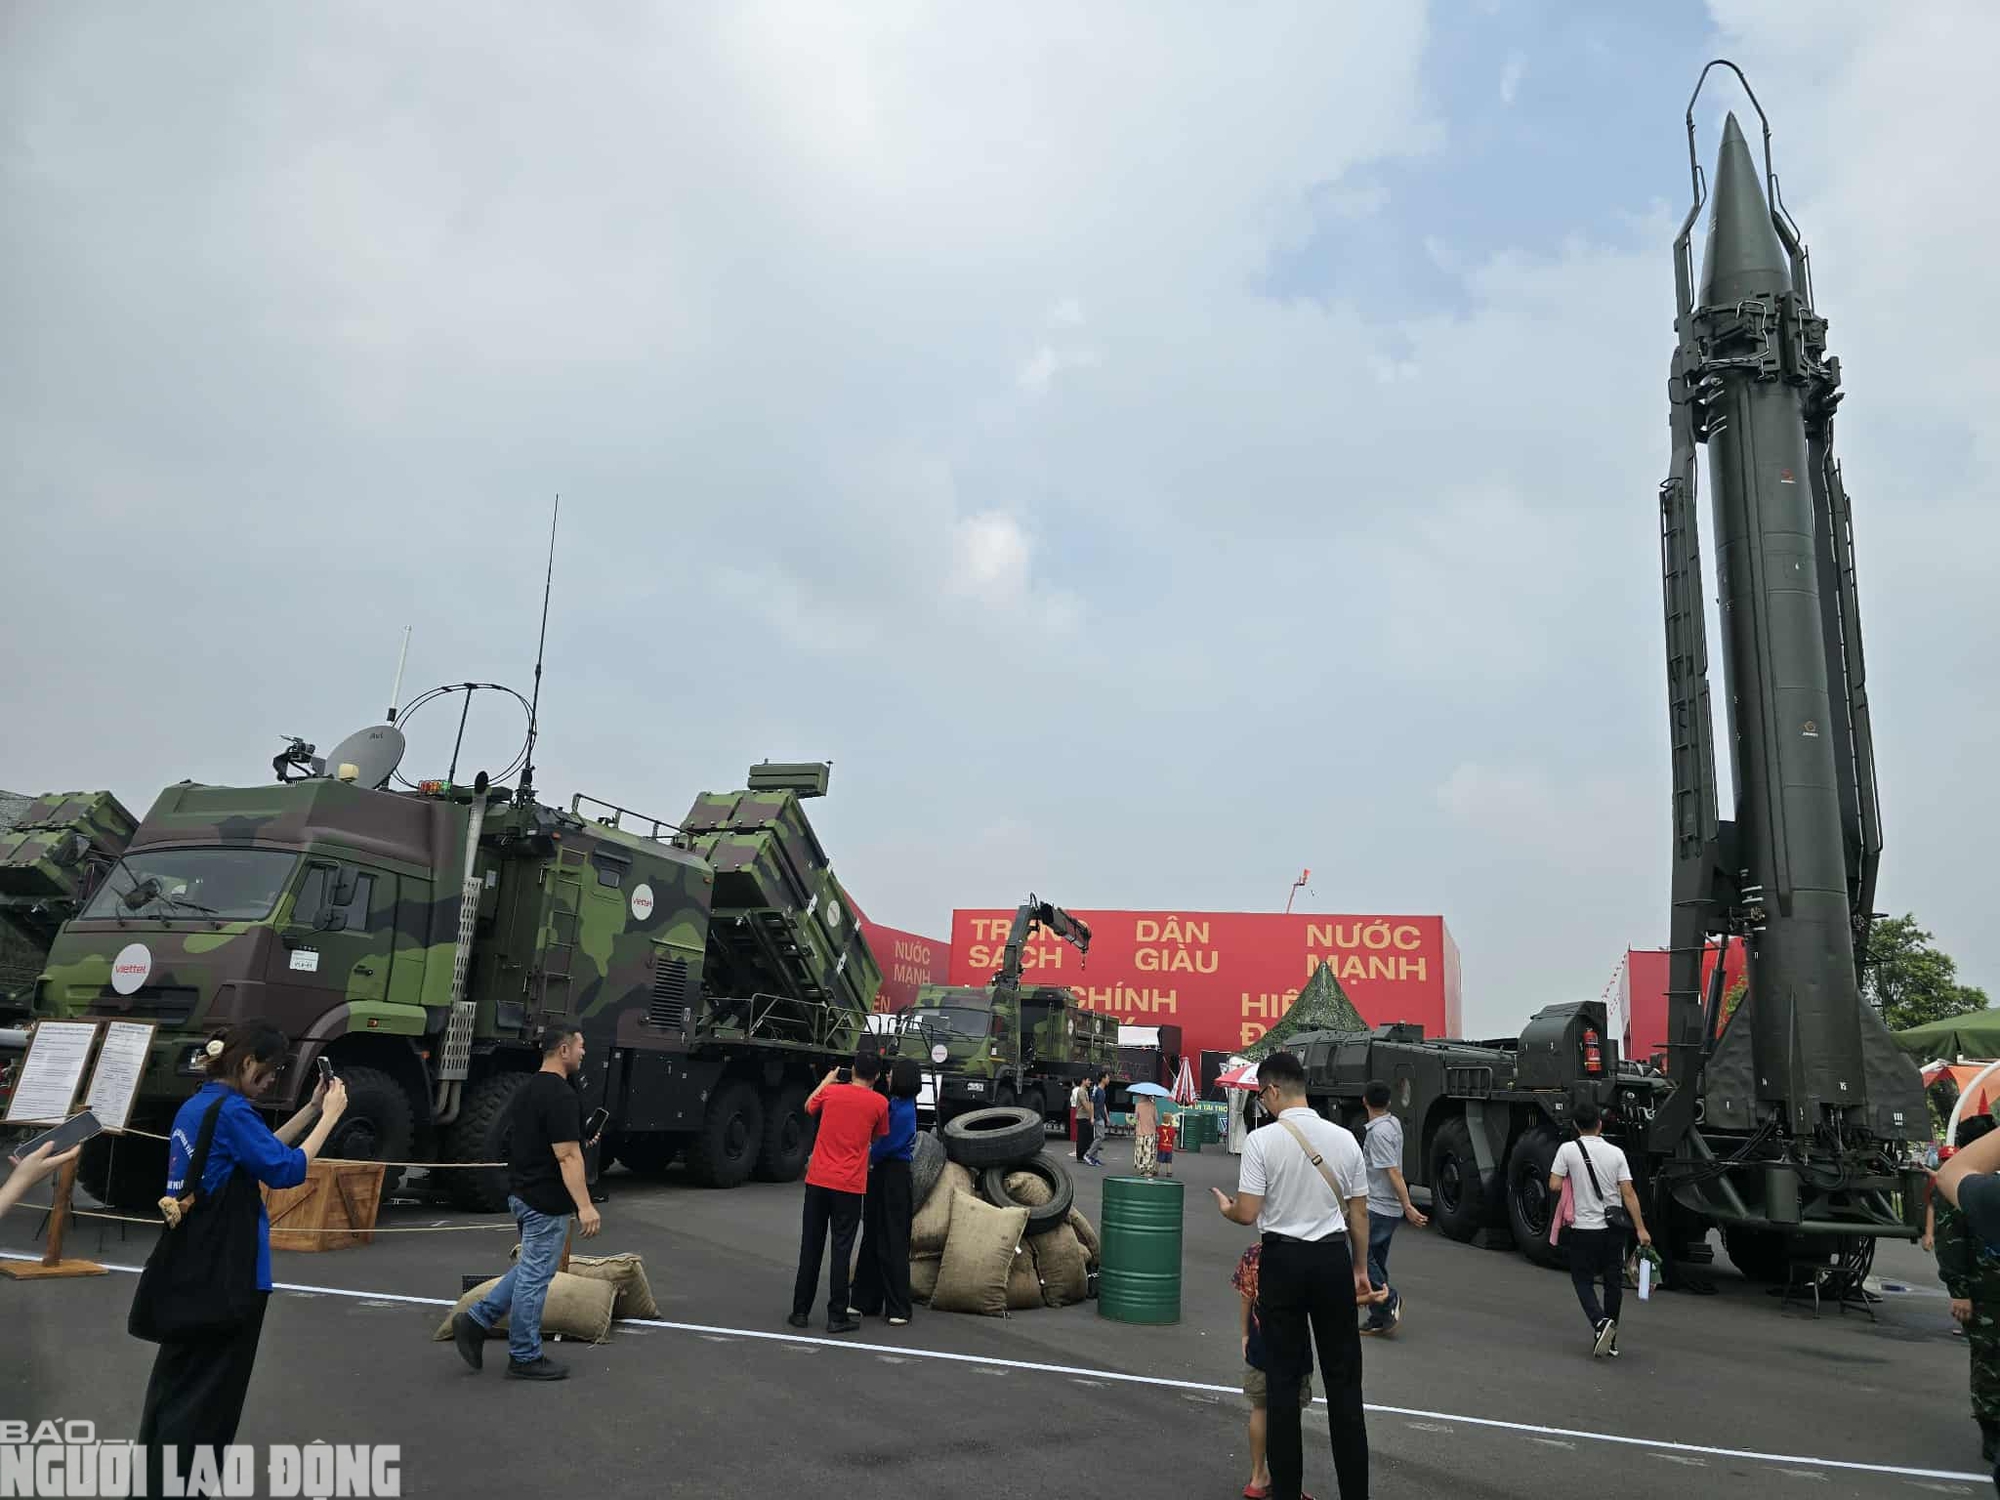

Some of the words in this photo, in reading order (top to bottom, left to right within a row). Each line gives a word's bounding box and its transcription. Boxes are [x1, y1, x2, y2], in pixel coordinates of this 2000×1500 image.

[970, 918, 1088, 942] TRN
[1136, 915, 1210, 944] DÂN
[1306, 918, 1421, 951] NƯỚC
[1134, 944, 1219, 973] GIÀU
[1306, 953, 1427, 985] MẠNH
